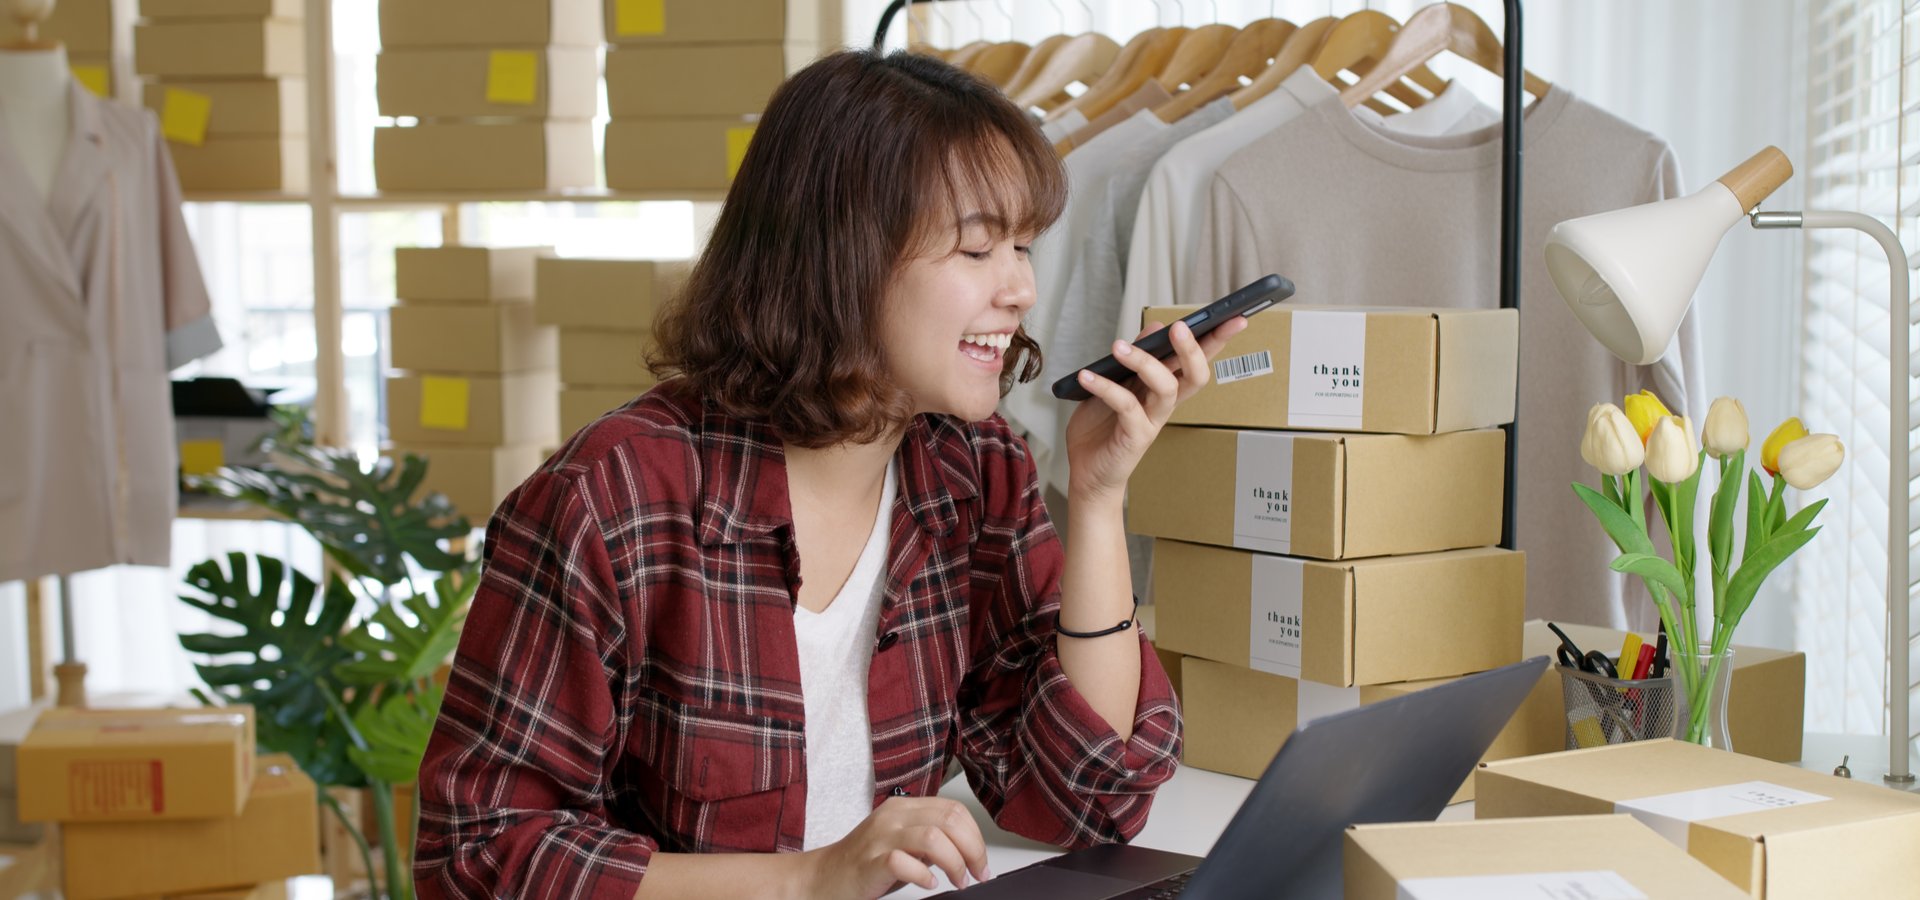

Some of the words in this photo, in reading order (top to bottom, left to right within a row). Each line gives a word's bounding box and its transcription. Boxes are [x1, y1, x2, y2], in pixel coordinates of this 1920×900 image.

[1313, 364, 1360, 376] thank
[1332, 378, 1360, 390] you
[1253, 487, 1288, 501] thank
[1266, 502, 1288, 514] you
[1267, 611, 1300, 627] thank
[1280, 627, 1300, 638] you
